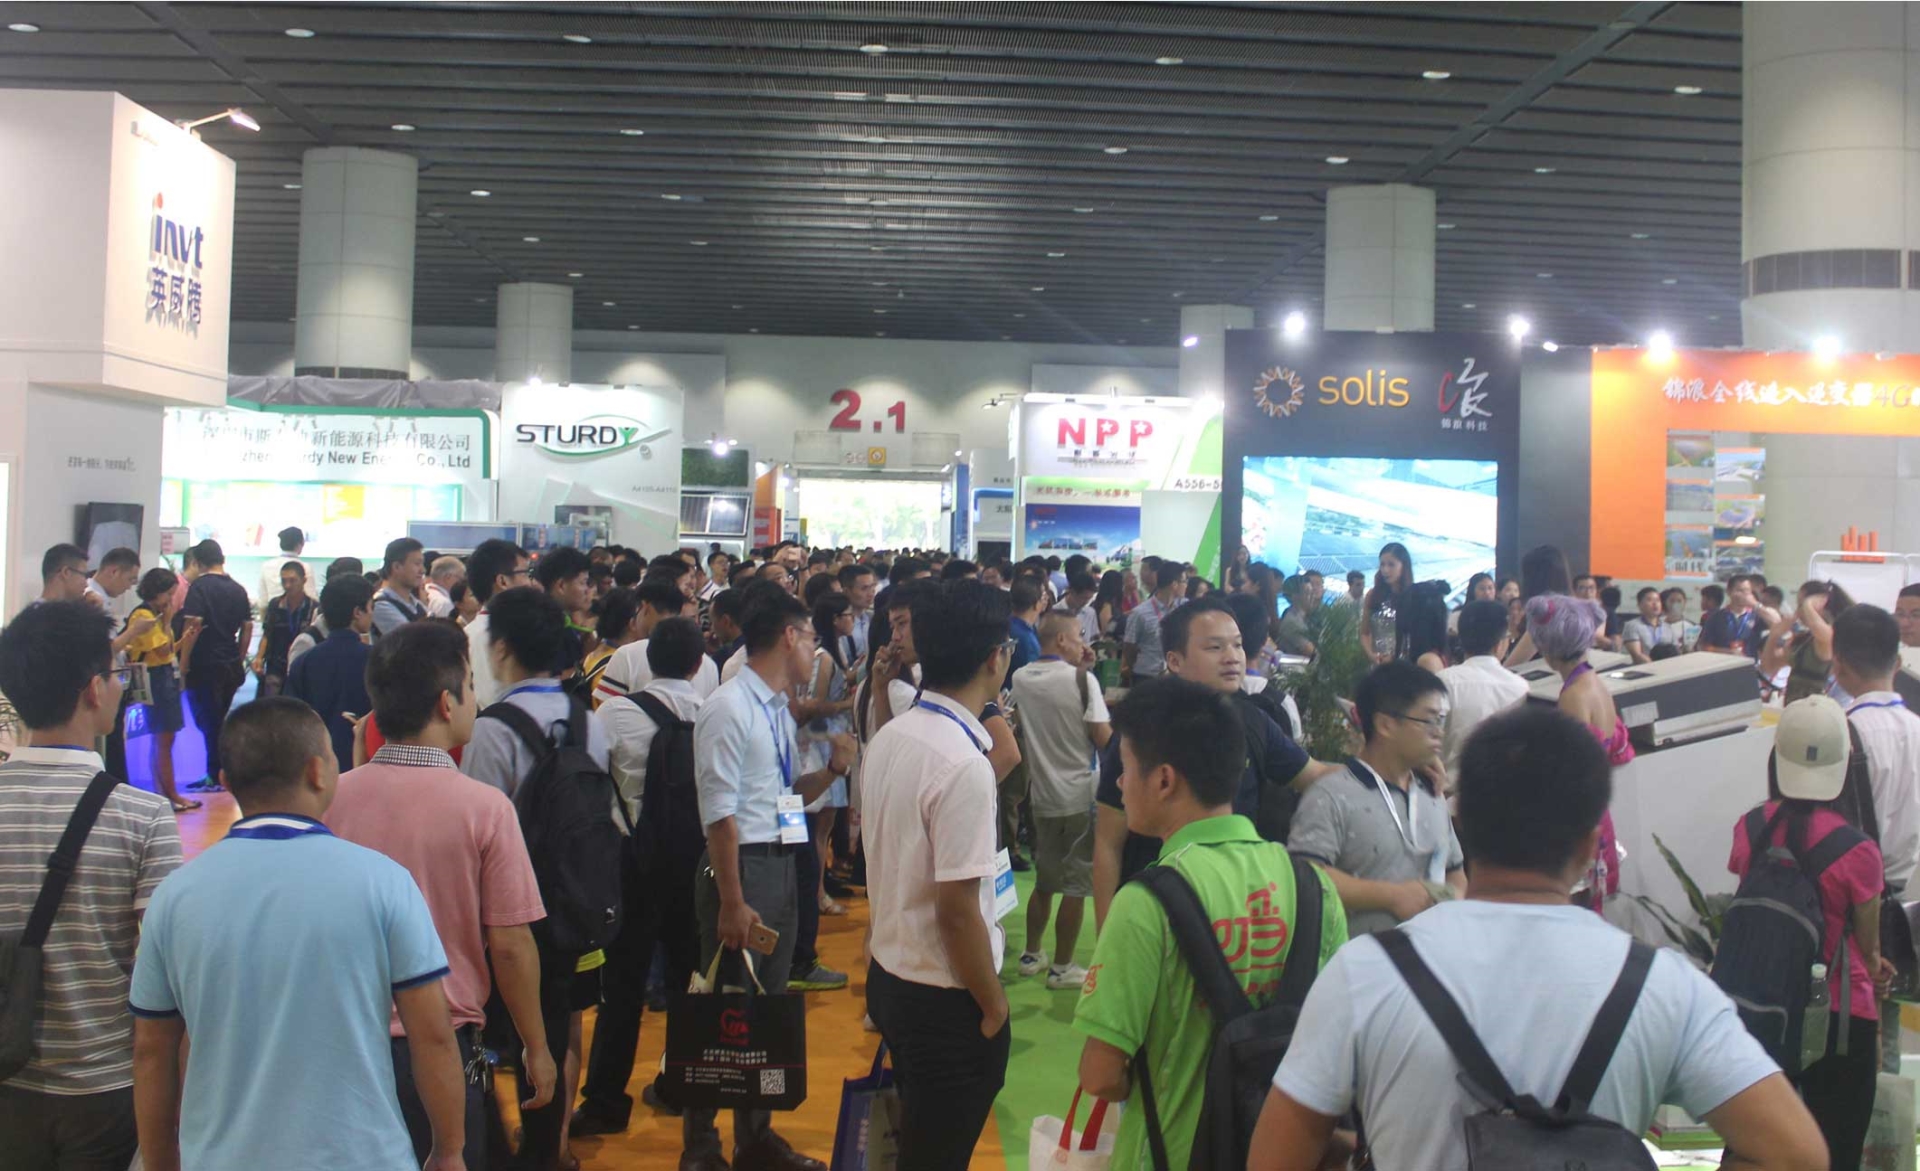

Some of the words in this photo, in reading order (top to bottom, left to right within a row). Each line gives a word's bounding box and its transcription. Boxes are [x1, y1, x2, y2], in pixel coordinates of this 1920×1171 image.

[154, 192, 204, 270] invt
[1318, 369, 1411, 407] solis
[828, 388, 906, 433] 2.1
[516, 423, 640, 446] STURDY
[1057, 417, 1154, 448] NPP
[328, 451, 357, 464] New
